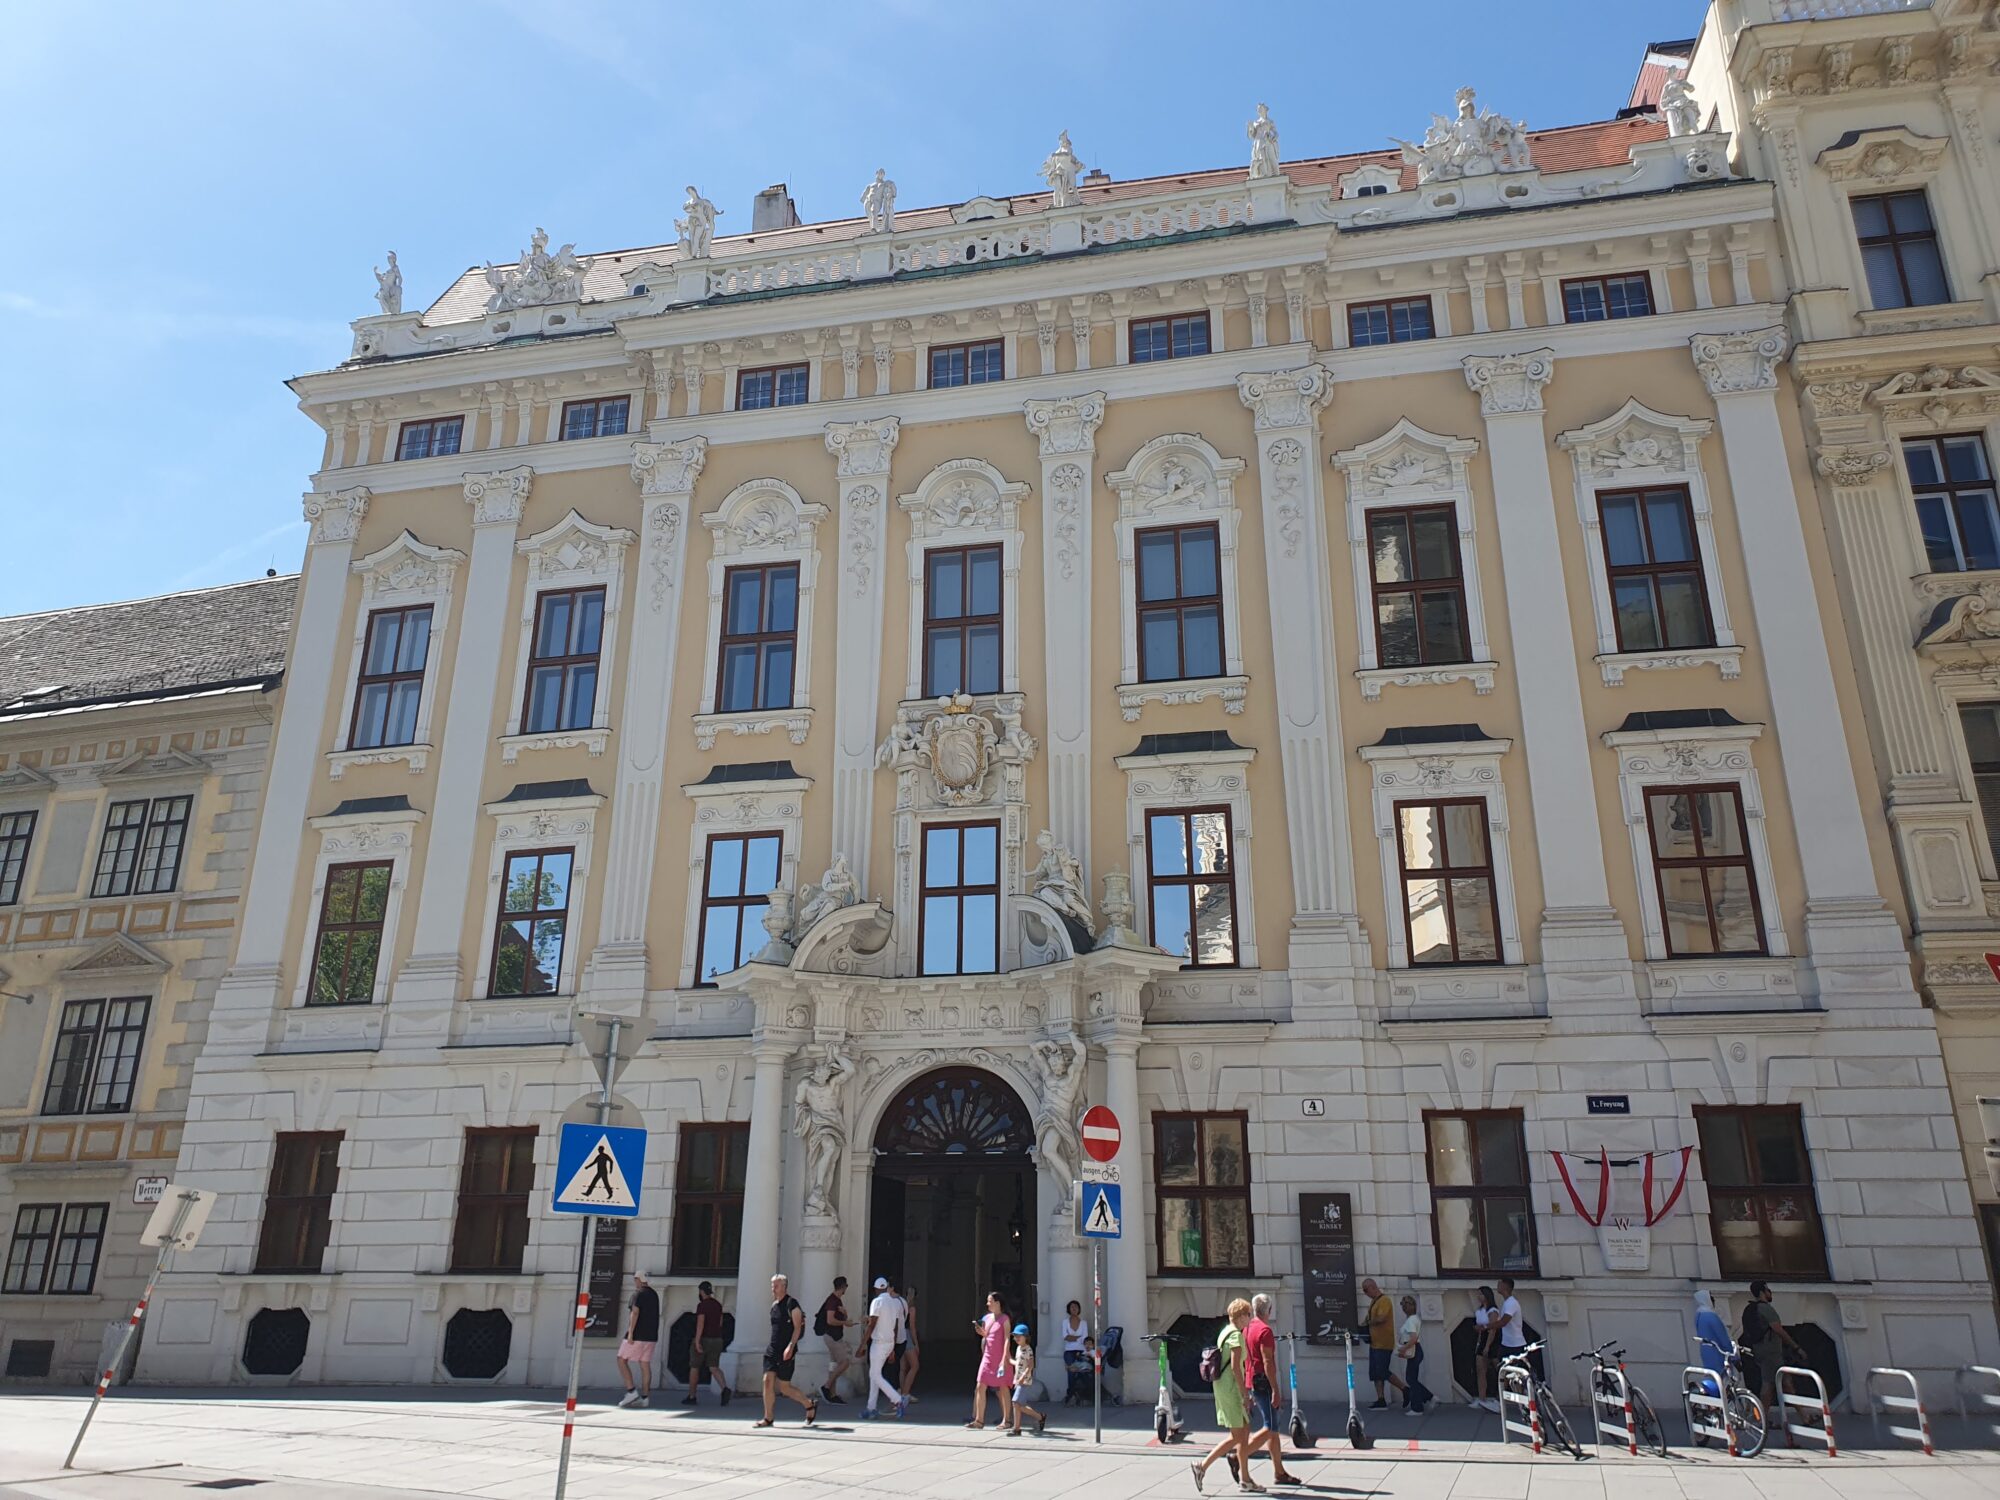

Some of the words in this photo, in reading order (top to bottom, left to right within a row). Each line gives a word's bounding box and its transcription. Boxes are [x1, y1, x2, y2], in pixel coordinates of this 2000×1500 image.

[1309, 1100, 1317, 1111] 4
[1600, 1100, 1625, 1108] Freyung
[1325, 1271, 1347, 1280] Kinsky
